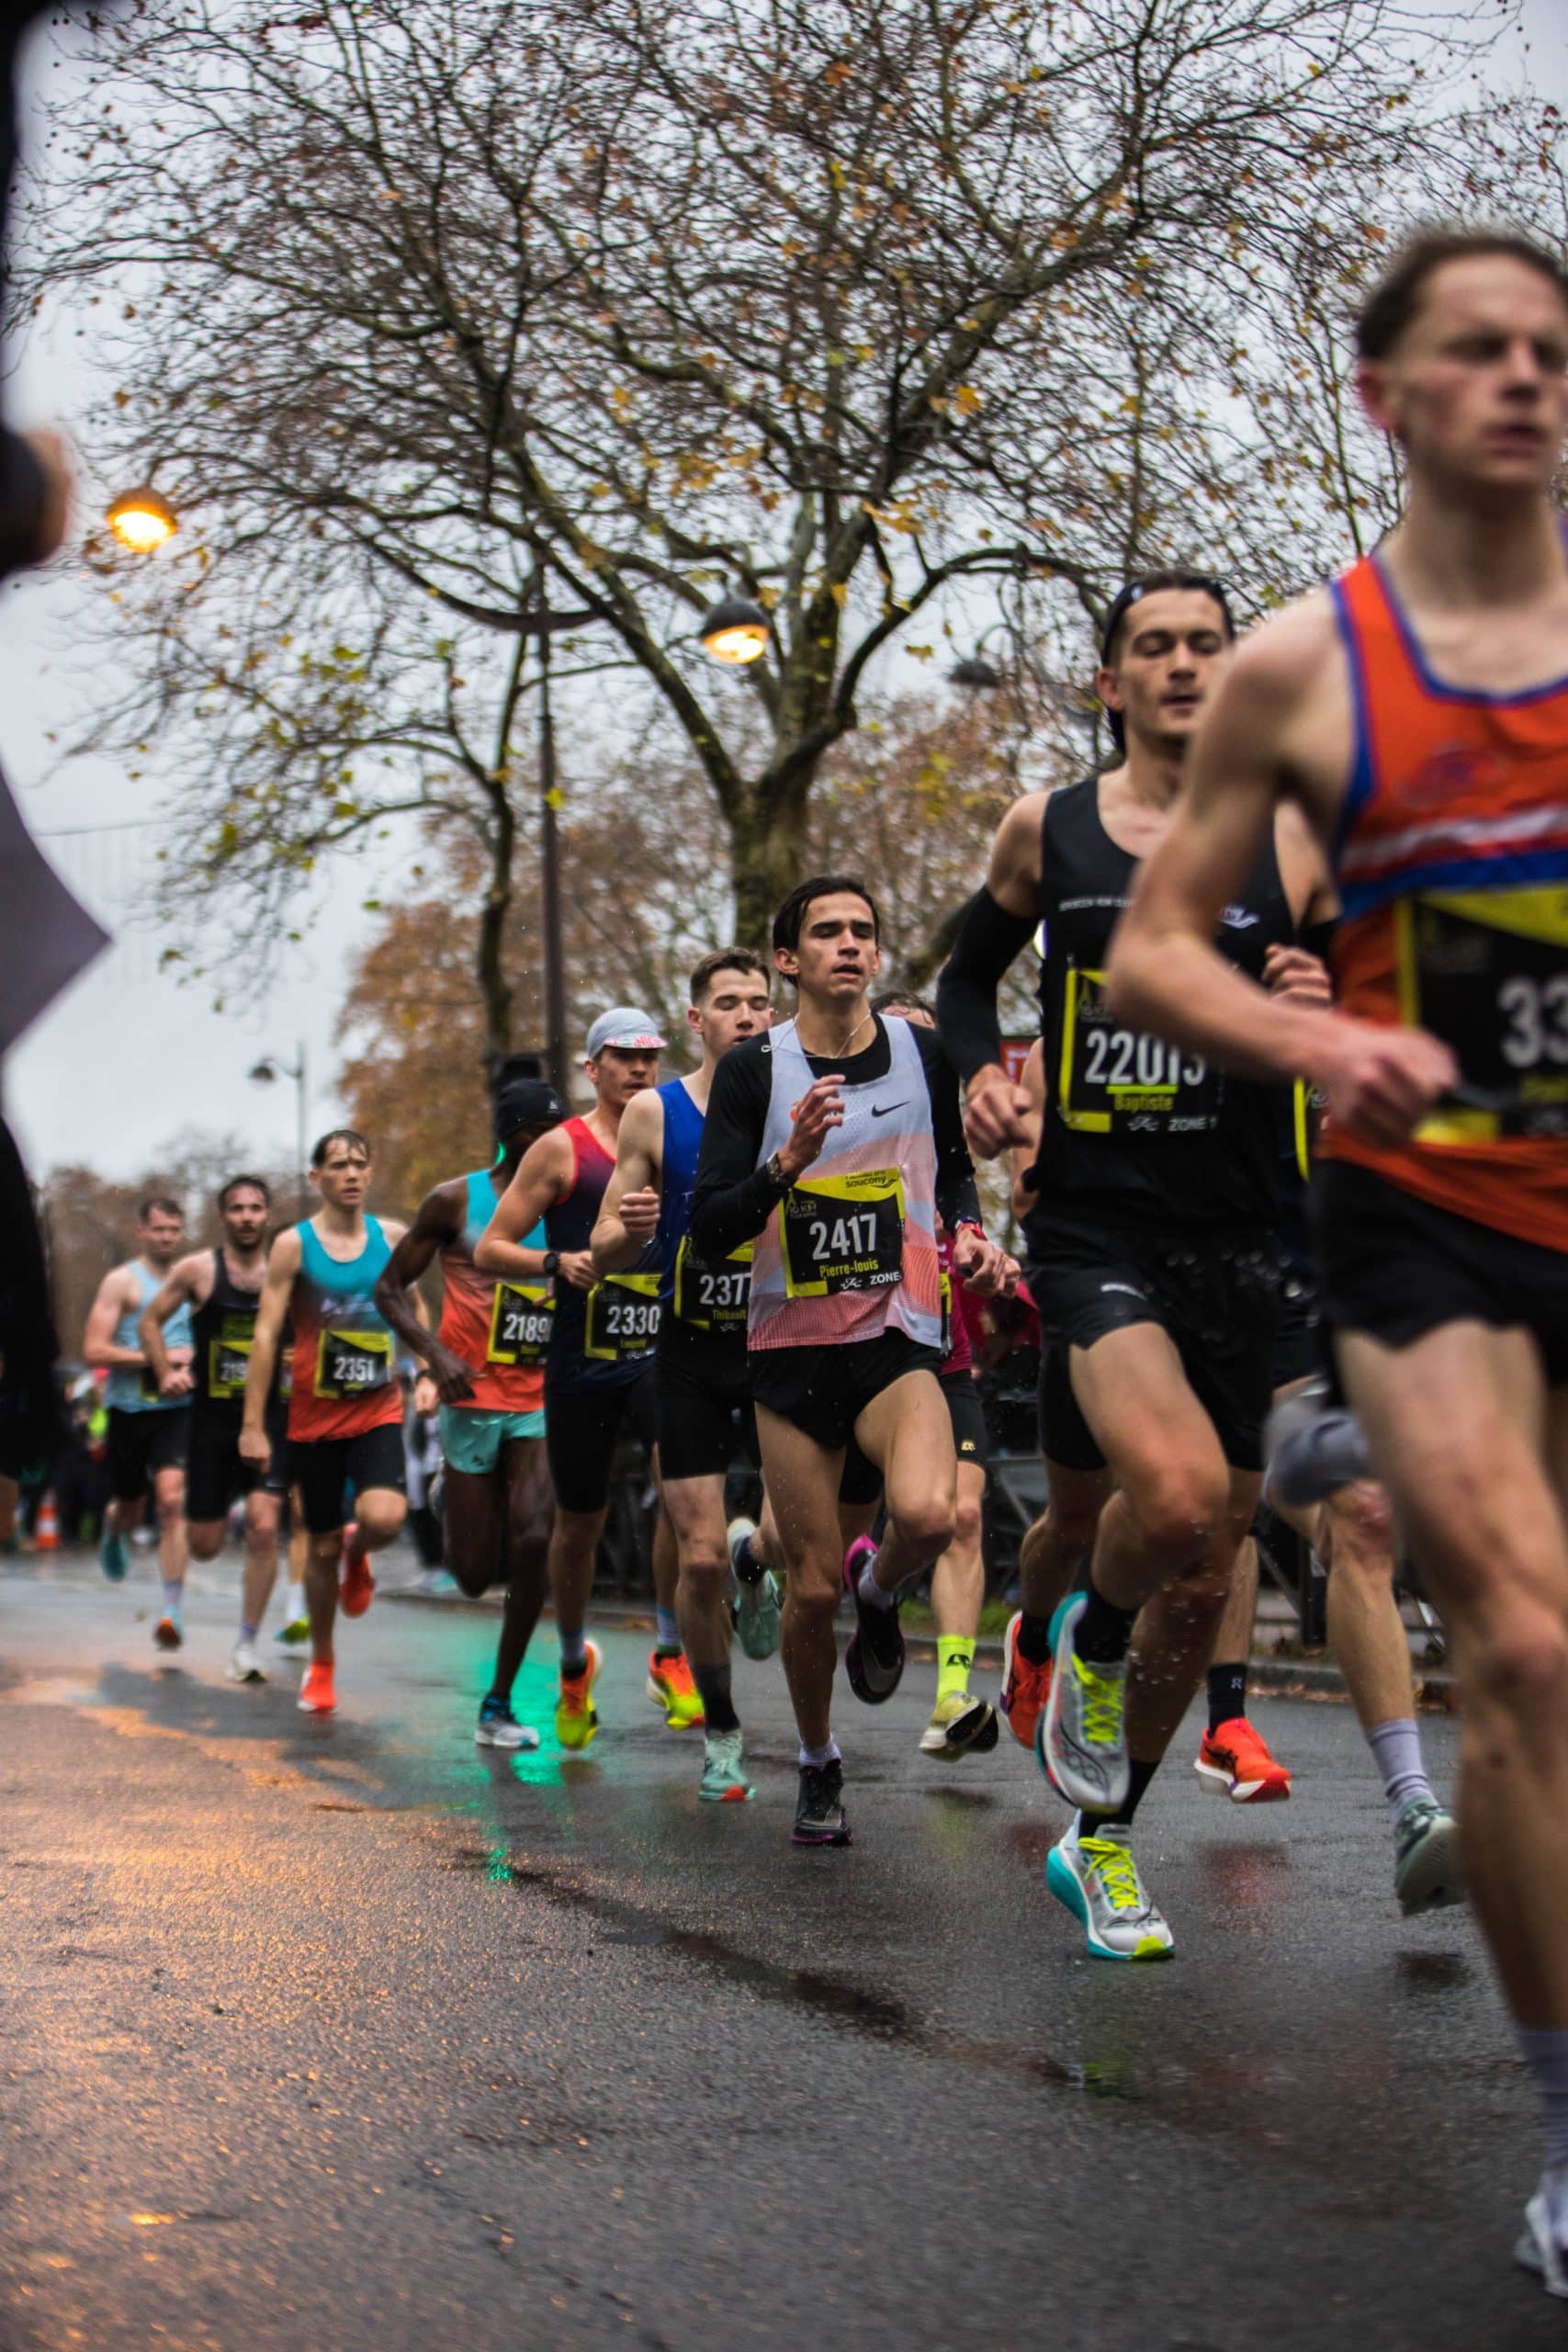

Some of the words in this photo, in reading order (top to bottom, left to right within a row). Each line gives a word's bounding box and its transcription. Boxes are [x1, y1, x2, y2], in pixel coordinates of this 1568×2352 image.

[1114, 1095, 1176, 1114] Baptiste
[1168, 1117, 1206, 1132] ZONE
[846, 1175, 886, 1189] saucony
[809, 1213, 876, 1261] 2417
[819, 1259, 879, 1277] Pierre-louis
[870, 1272, 900, 1285] ZONE
[502, 1313, 554, 1344] 2189
[605, 1305, 661, 1336] 2330
[333, 1356, 376, 1382] 2351
